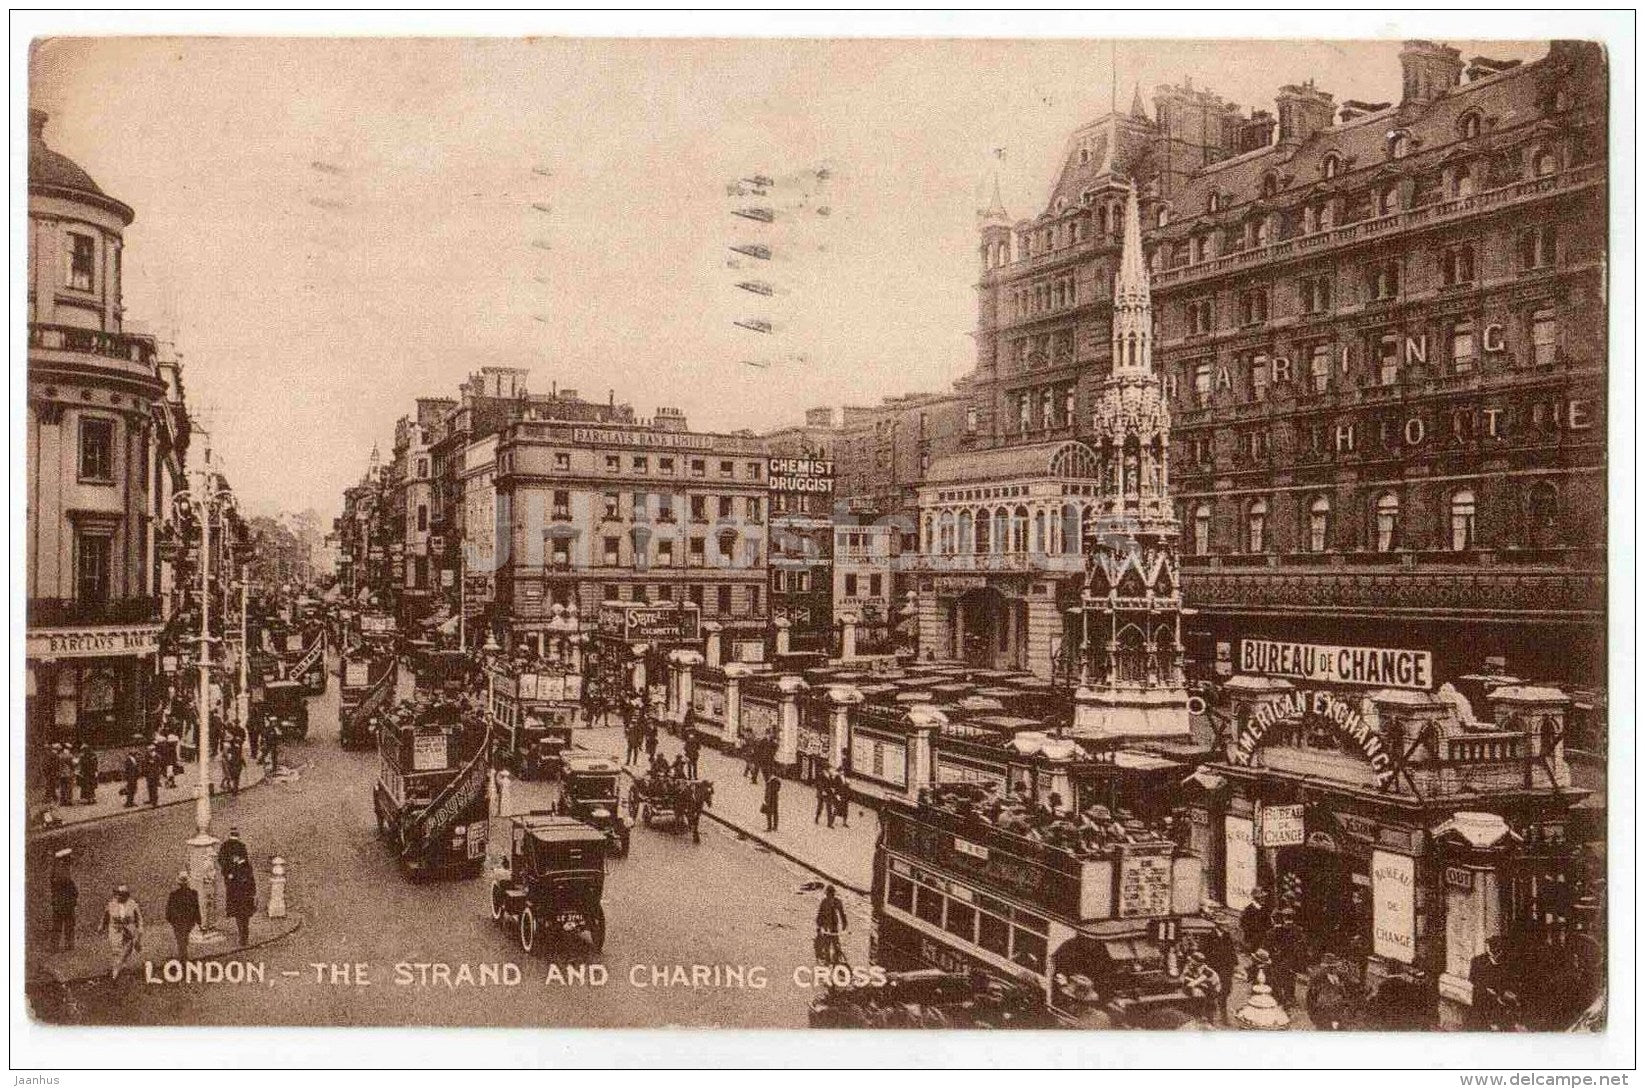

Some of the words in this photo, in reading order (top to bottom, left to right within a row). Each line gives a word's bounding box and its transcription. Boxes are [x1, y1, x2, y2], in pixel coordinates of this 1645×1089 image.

[1163, 324, 1504, 397] HARING
[1336, 400, 1591, 450] HOTE
[576, 428, 635, 445] BARCLAYS
[638, 433, 668, 446] BANK
[770, 459, 834, 474] CHEMIST
[769, 476, 834, 492] DRUGGIST
[50, 637, 114, 652] BARCLAYS
[1244, 641, 1315, 676] BUREAU
[1319, 653, 1334, 673] DE
[1337, 649, 1426, 687] CHANGE
[1235, 689, 1307, 766] AMERICAN
[1313, 690, 1394, 787] EXCHANGE
[1264, 829, 1304, 842] CHANGE
[1374, 866, 1413, 887] BUREAU
[1375, 927, 1411, 948] CHANGE
